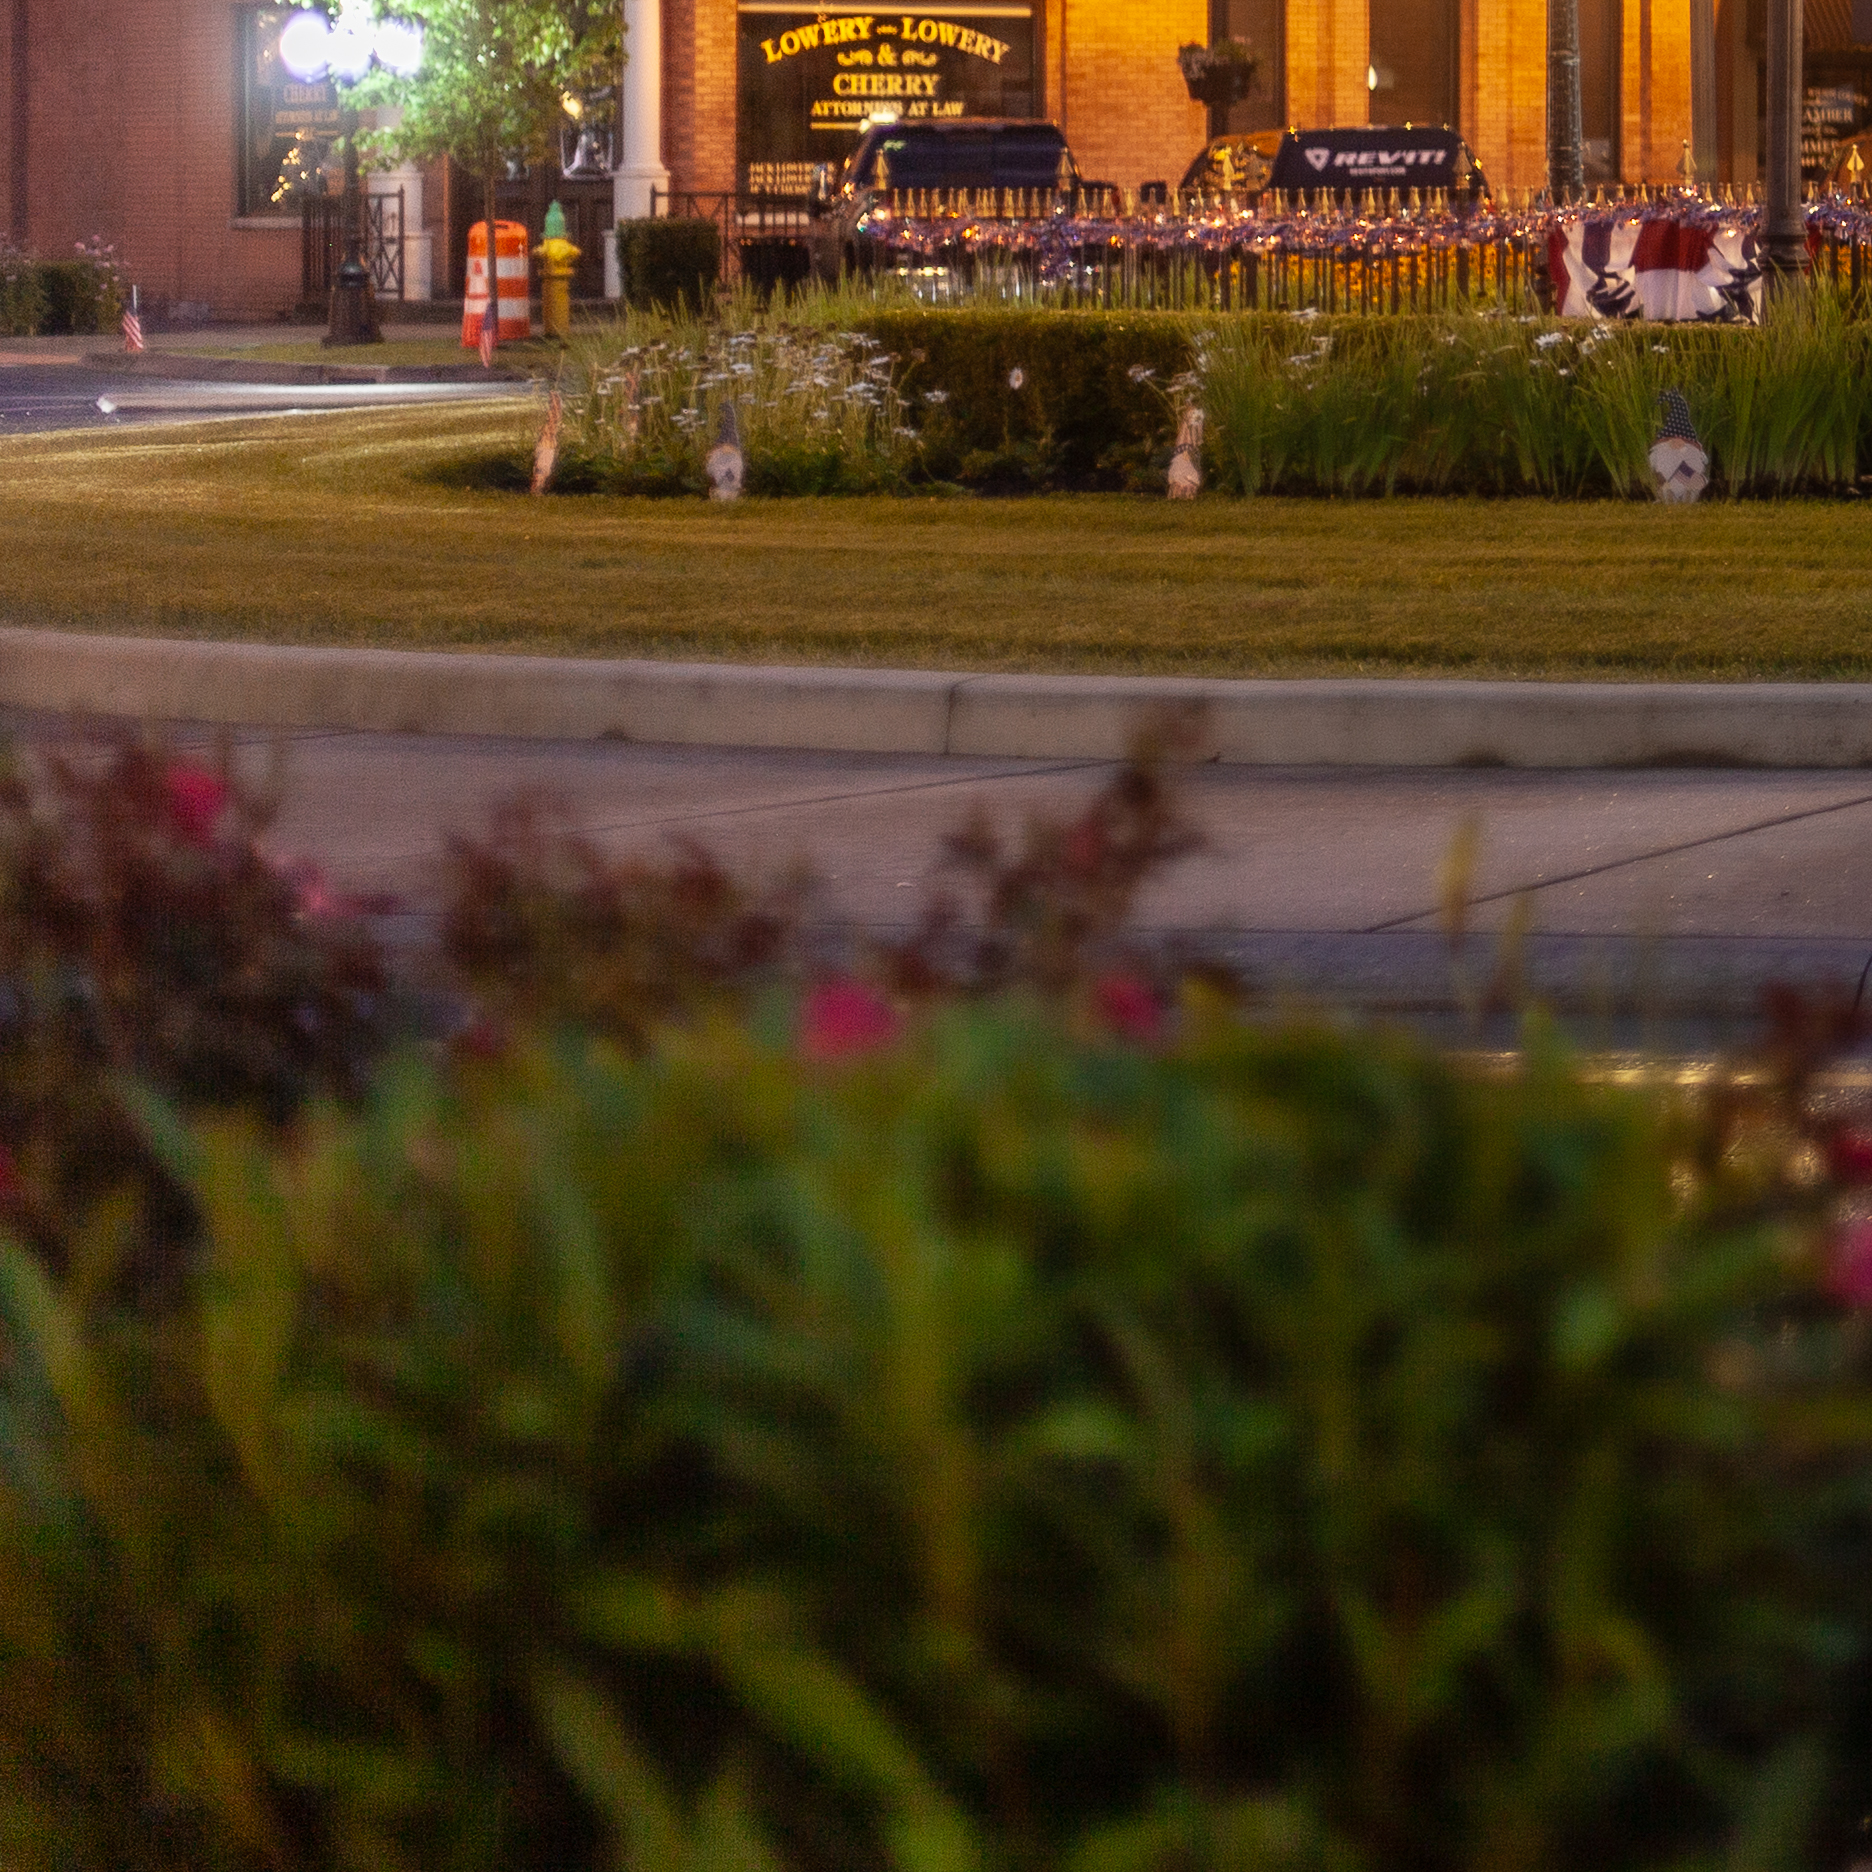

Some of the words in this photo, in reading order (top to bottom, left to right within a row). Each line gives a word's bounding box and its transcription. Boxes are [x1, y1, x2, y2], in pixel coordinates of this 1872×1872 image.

[760, 16, 875, 65] LOWERY
[901, 16, 1011, 65] LOWERY
[876, 42, 898, 67] &
[832, 72, 941, 97] CHERRY
[810, 99, 904, 117] ATTORNEYS
[908, 100, 928, 117] AT
[932, 100, 965, 117] LAW
